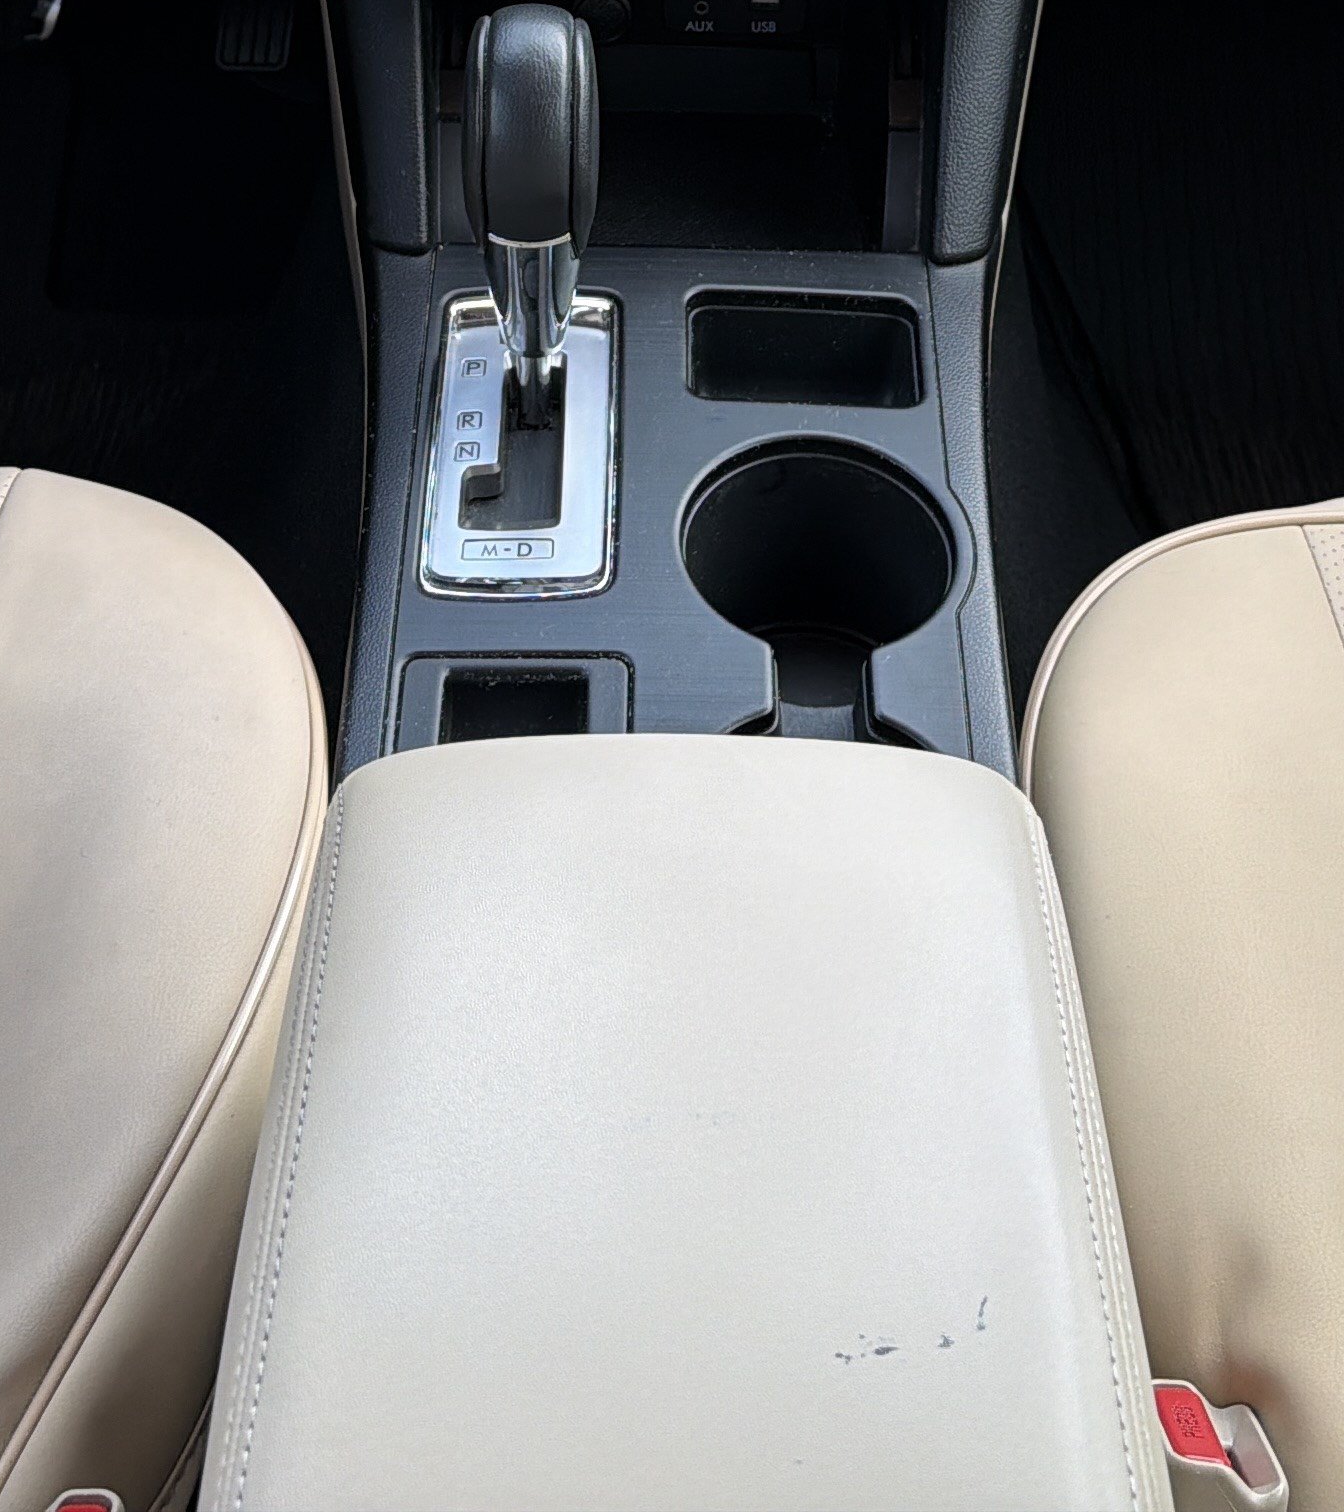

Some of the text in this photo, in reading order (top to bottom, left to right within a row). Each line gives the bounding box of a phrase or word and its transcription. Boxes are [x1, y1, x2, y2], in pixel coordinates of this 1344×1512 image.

[685, 21, 714, 32] AUX
[751, 21, 776, 33] USB
[466, 362, 481, 375] P
[461, 414, 475, 427] R
[458, 446, 474, 459] N
